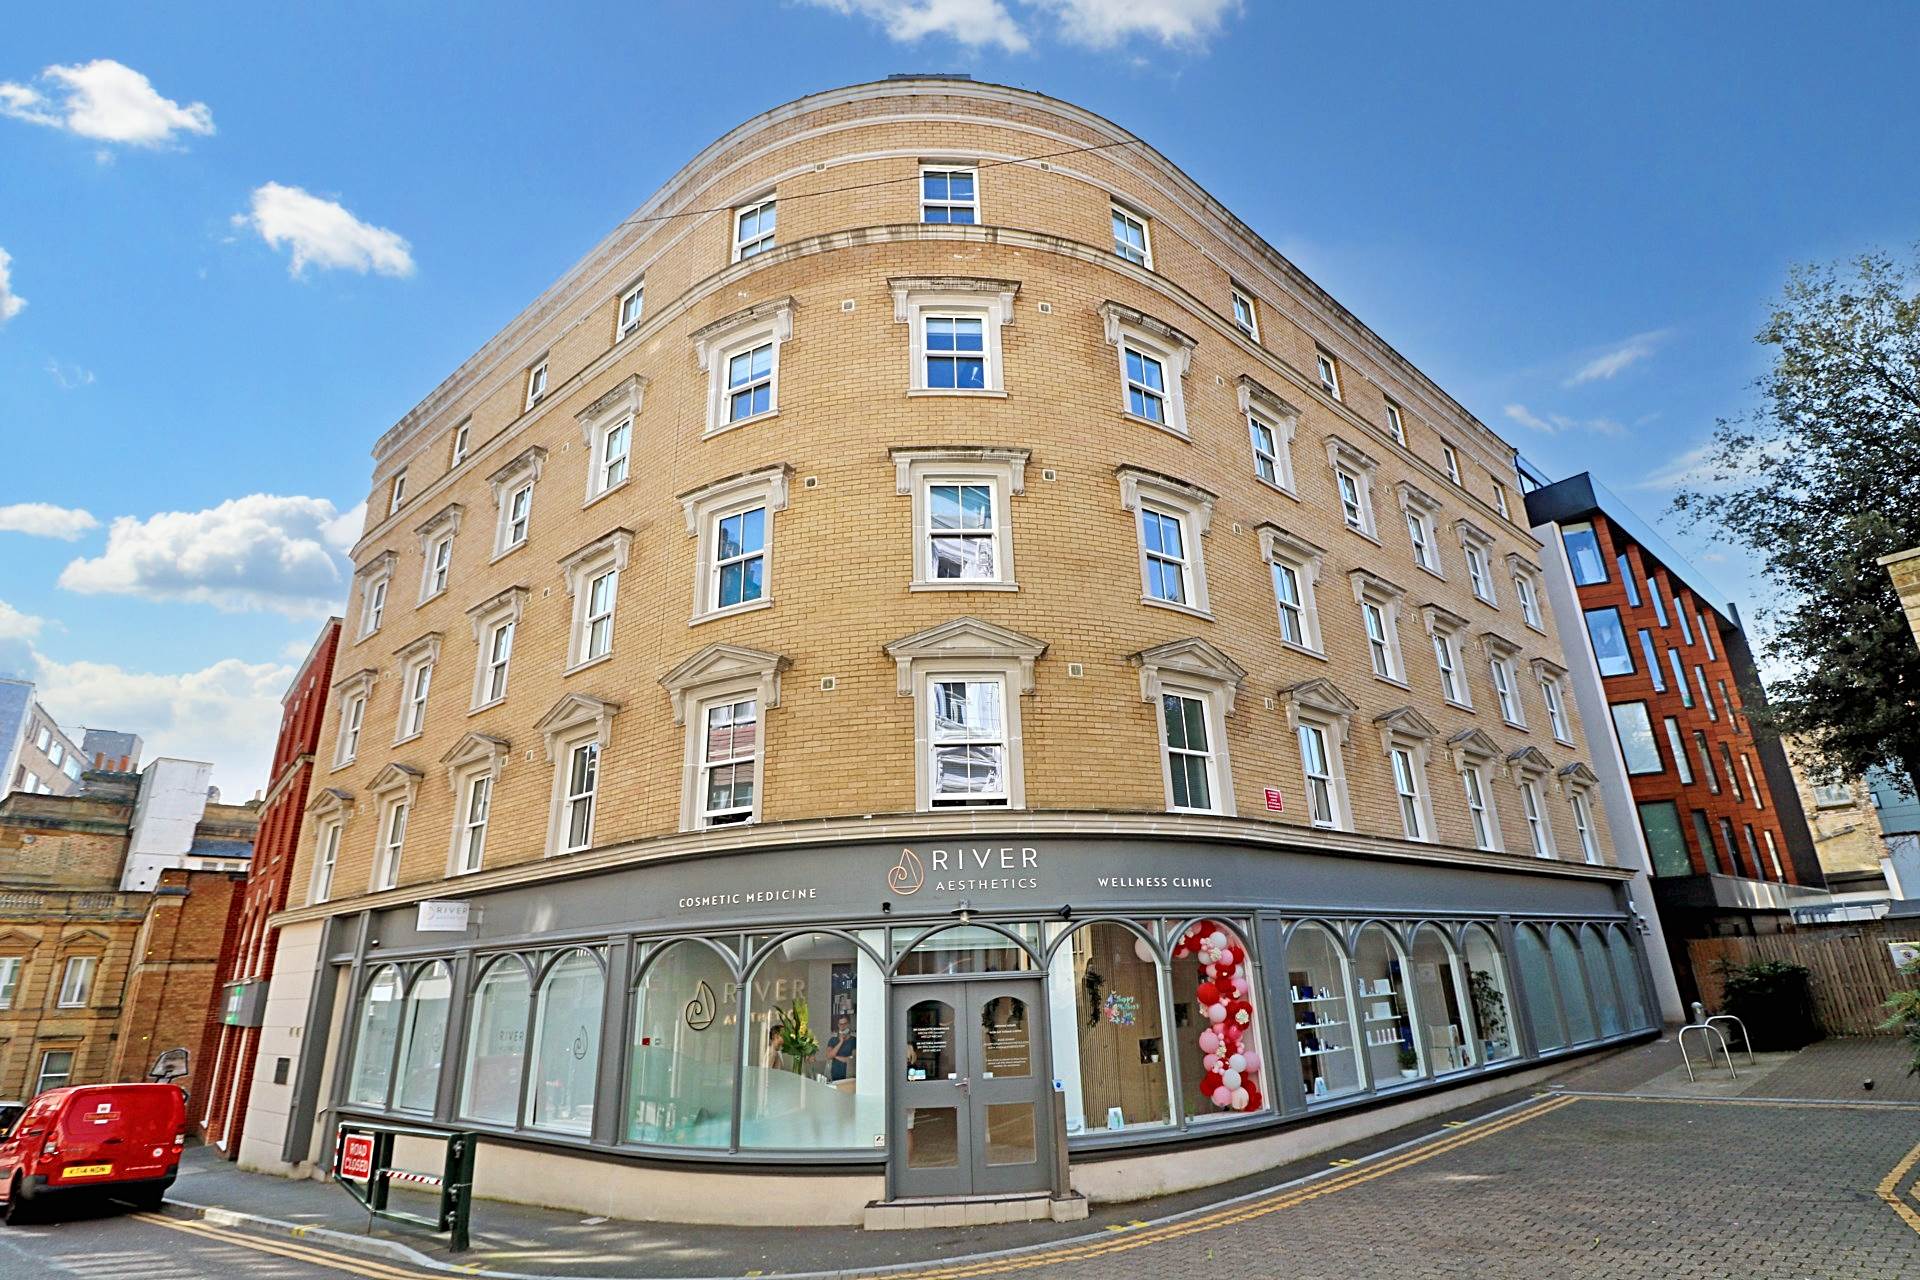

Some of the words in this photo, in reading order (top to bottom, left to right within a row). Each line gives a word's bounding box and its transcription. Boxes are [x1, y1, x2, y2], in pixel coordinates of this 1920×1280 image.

[932, 848, 1038, 871] RIVER
[936, 878, 1038, 891] AESTHETICS
[1098, 877, 1168, 888] WELLNESS
[1172, 878, 1212, 888] CLINIC
[679, 894, 740, 908] COSMETIC
[746, 888, 817, 903] MEDICINE
[723, 979, 806, 1003] RVER
[350, 1142, 368, 1157] ROAD
[345, 1157, 369, 1172] CLOSED
